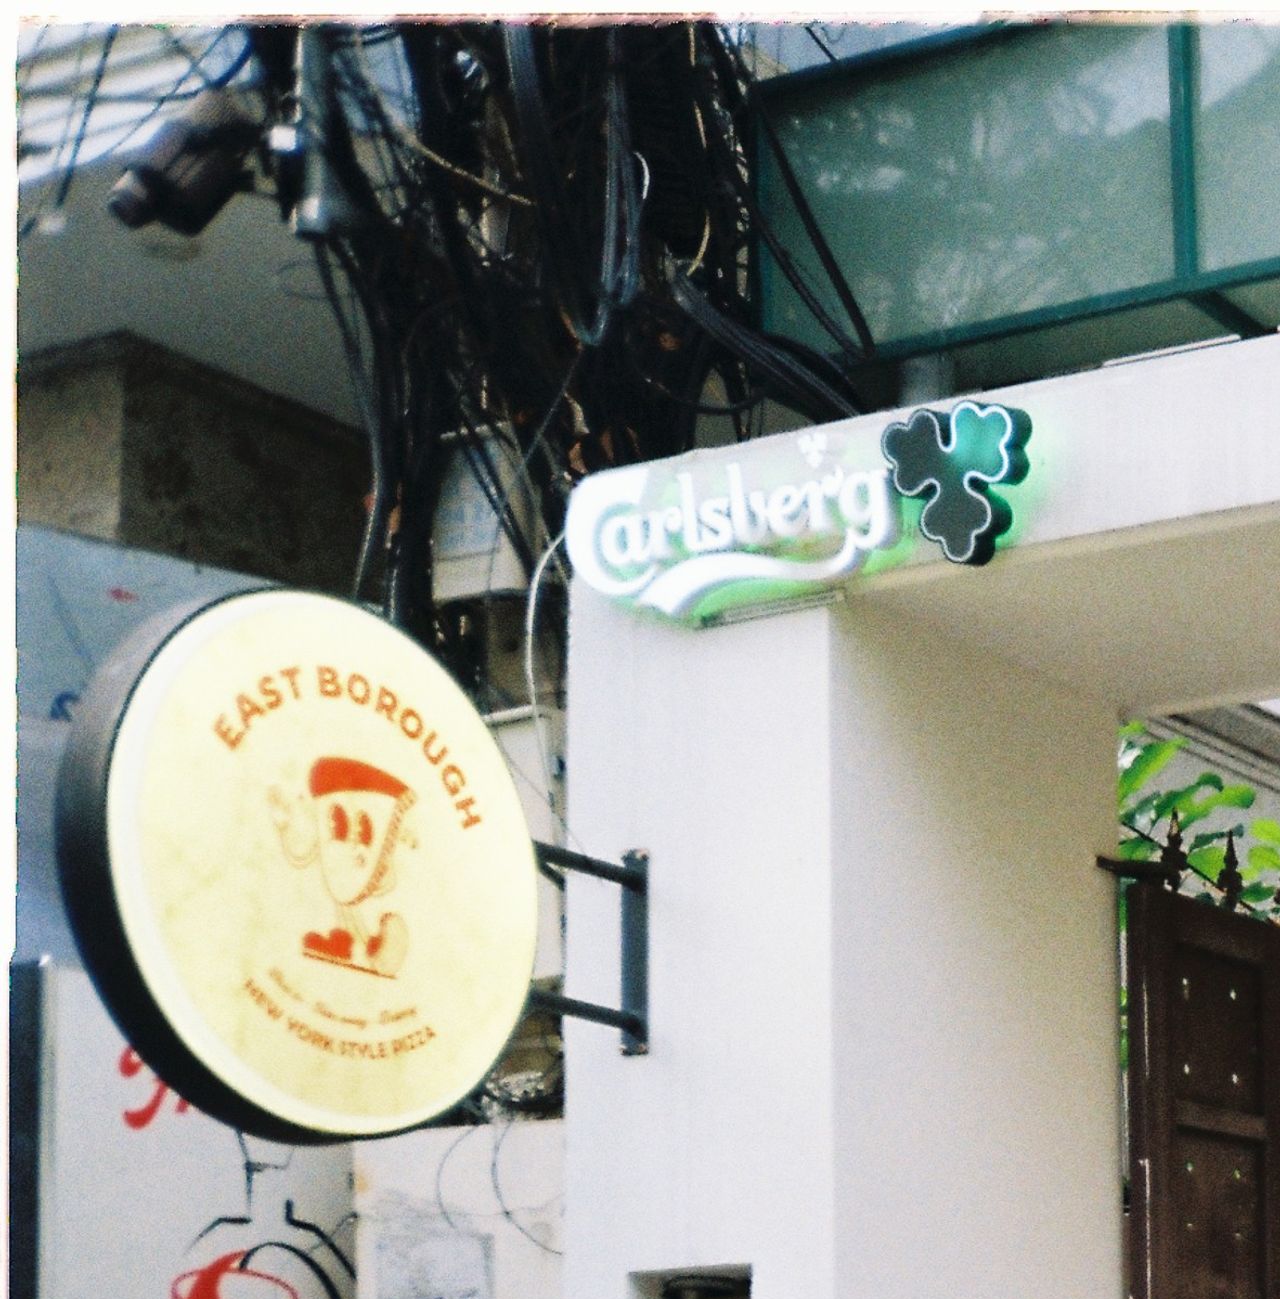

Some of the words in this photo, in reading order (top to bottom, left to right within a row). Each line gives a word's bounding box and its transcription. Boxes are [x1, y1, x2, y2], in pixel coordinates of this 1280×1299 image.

[566, 462, 895, 617] Carlsberg
[213, 665, 301, 751] EAST
[316, 665, 482, 830] BOROUGH
[245, 977, 284, 1020] NEW
[287, 1016, 333, 1053] YORK
[339, 1039, 388, 1060] STYLE
[392, 1025, 437, 1055] PIZZA
